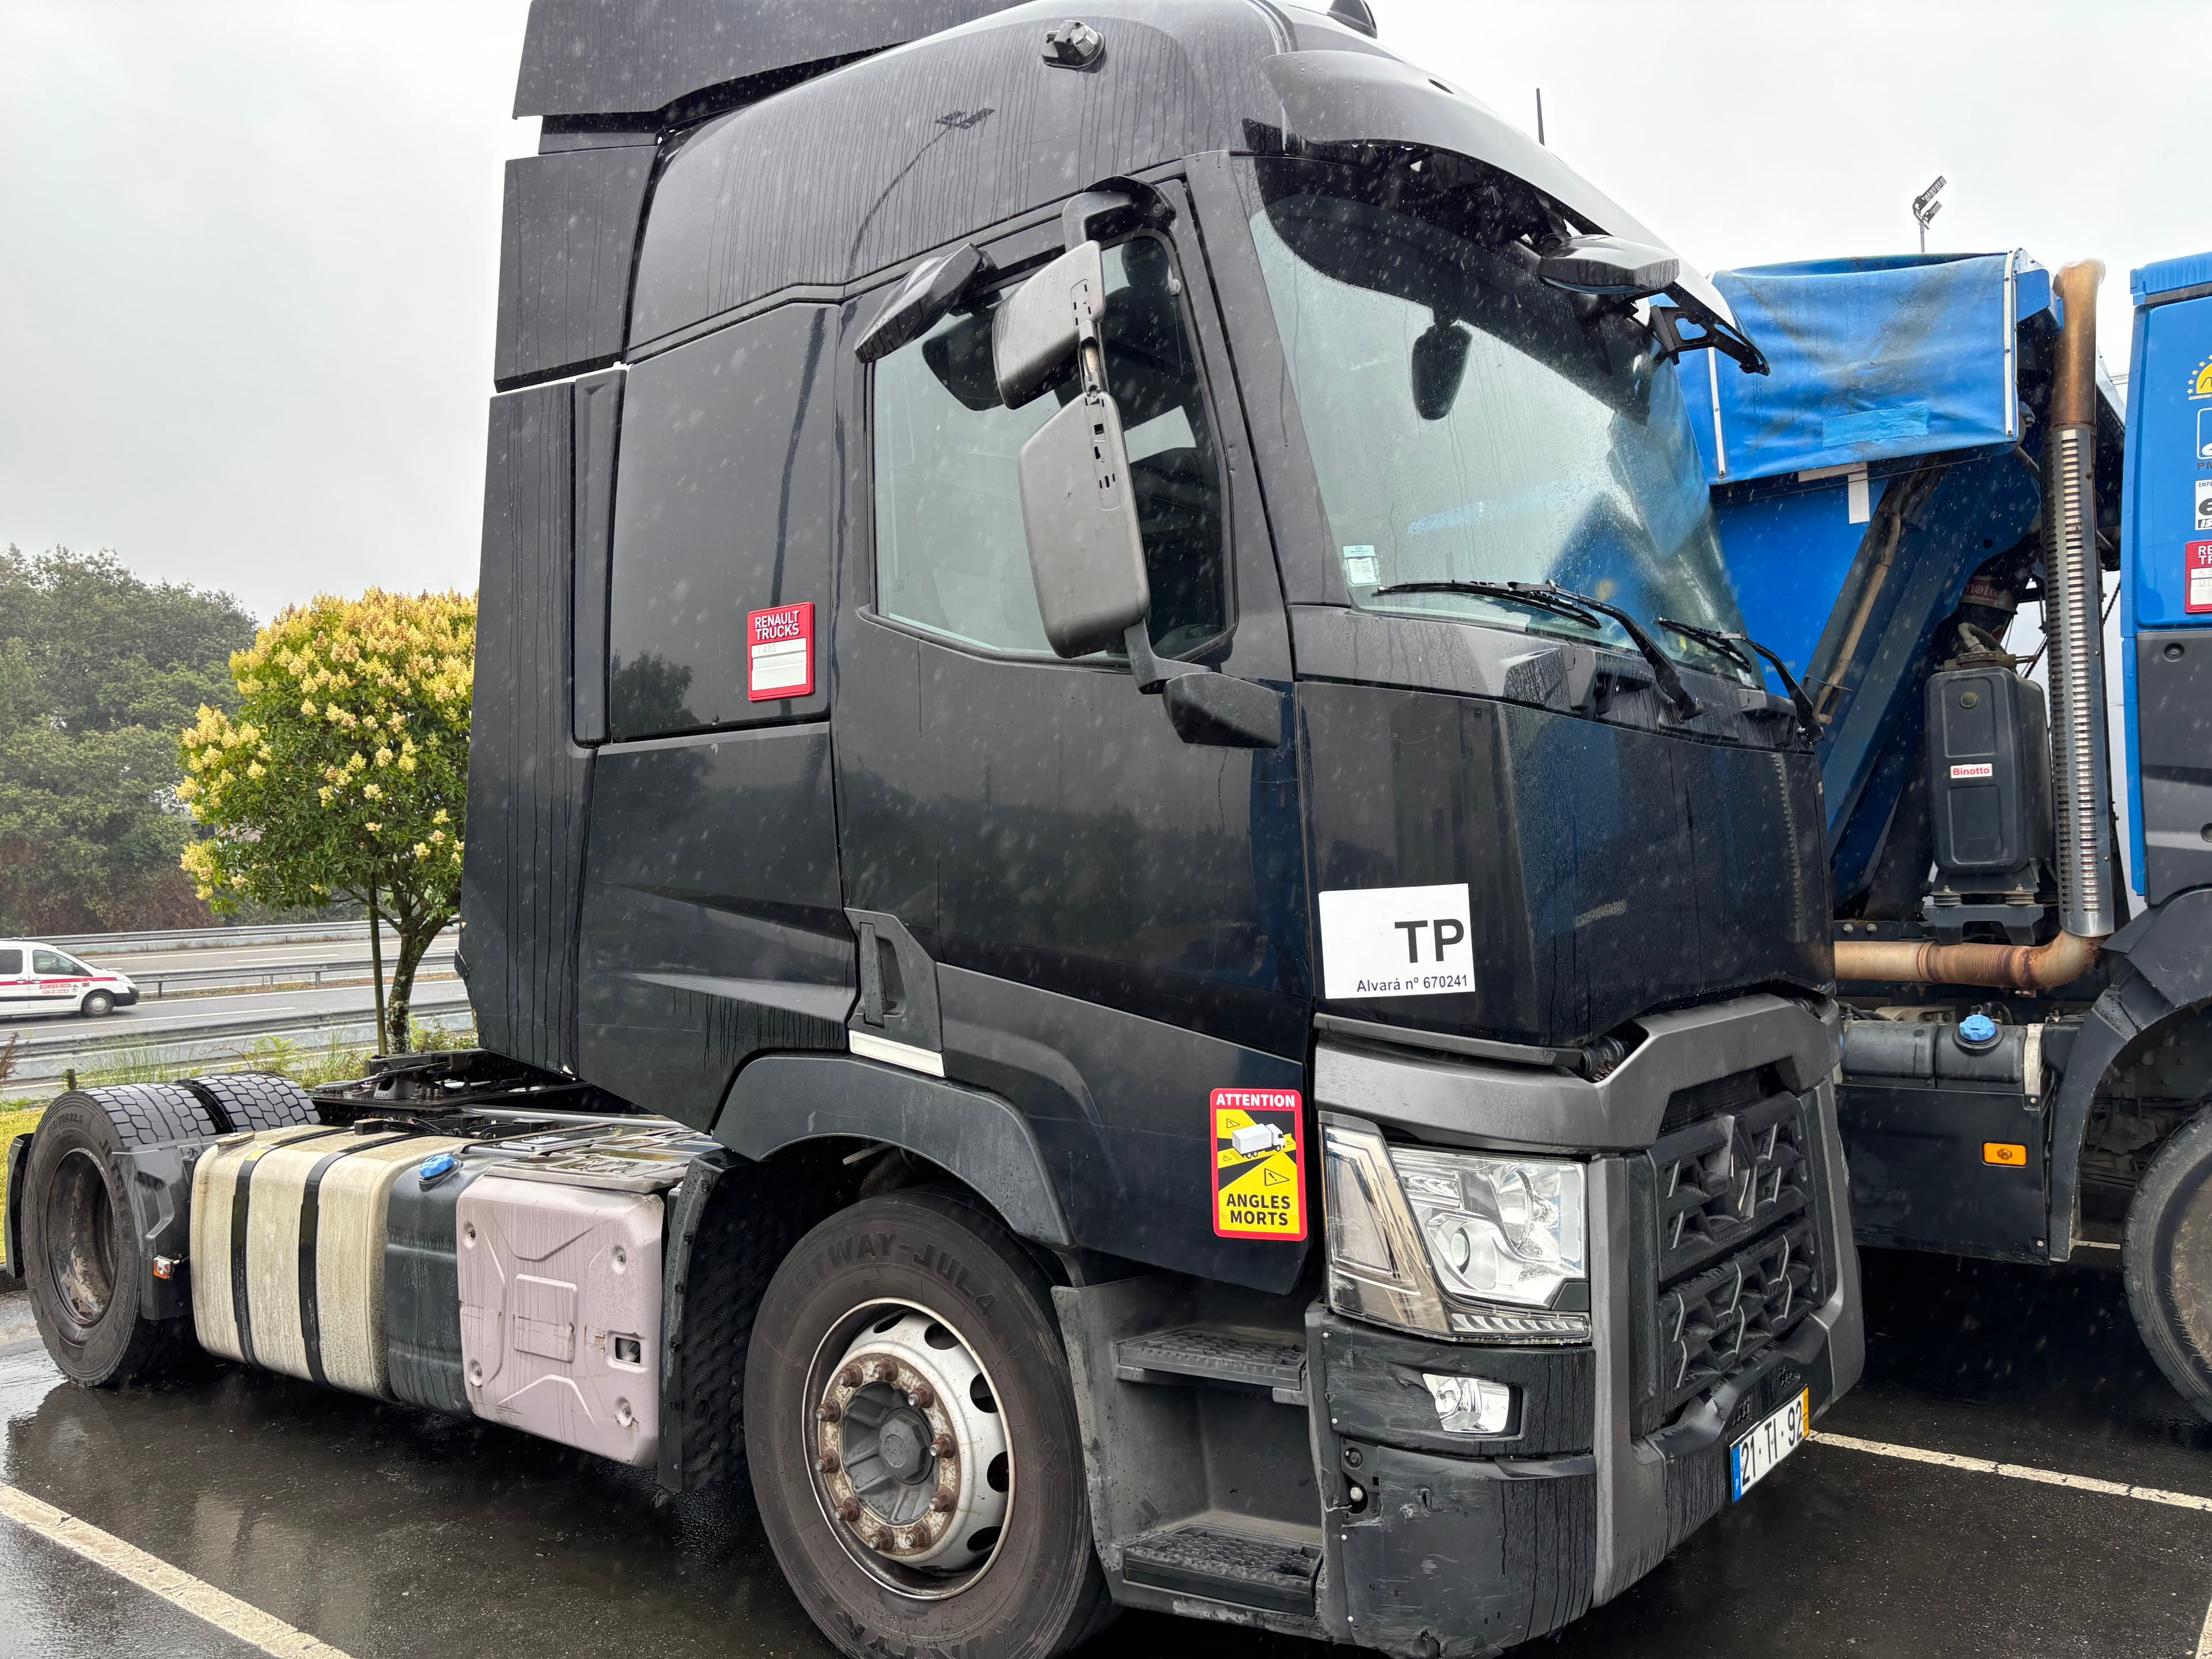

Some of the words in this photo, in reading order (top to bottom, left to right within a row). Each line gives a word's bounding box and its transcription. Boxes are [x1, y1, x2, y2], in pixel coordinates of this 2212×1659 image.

[755, 611, 799, 628] RENAULT
[755, 624, 800, 641] TRUCKS
[1953, 767, 1990, 775] Binotto
[1395, 918, 1464, 963] TP
[1357, 978, 1400, 992] Alvará
[1423, 974, 1468, 988] 670241
[1216, 1093, 1295, 1107] ATTENTION
[1226, 1193, 1290, 1210] ANGLES
[1230, 1210, 1288, 1226] MORTS
